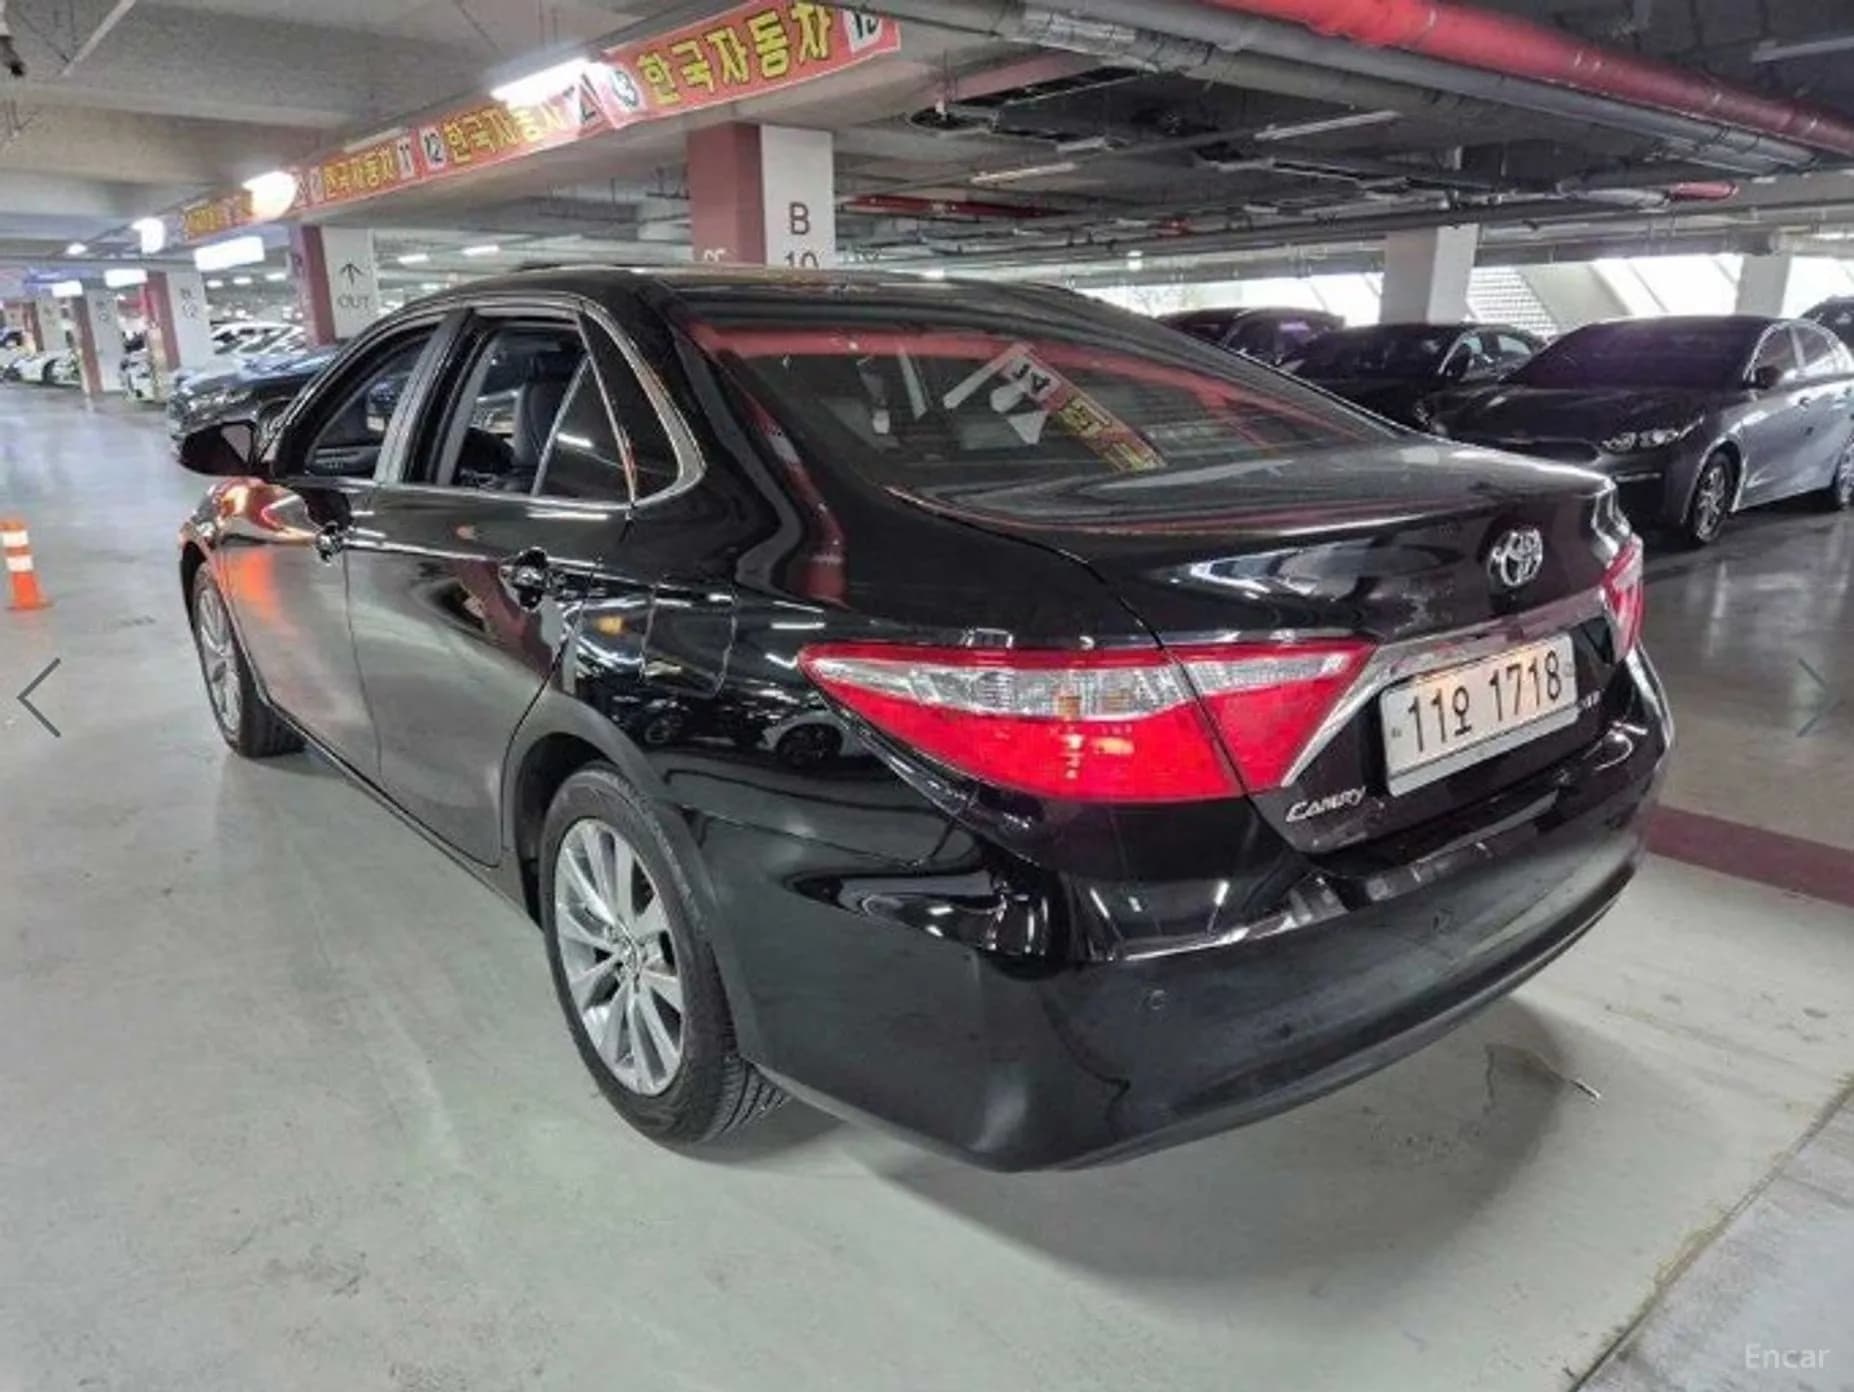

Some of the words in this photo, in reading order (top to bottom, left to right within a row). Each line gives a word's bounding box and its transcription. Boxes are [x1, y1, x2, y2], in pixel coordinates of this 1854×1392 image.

[636, 2, 832, 105] 한국자동차
[789, 202, 811, 236] B
[337, 294, 370, 309] OUT
[1407, 686, 1473, 753] 11오
[1489, 649, 1562, 722] 1718
